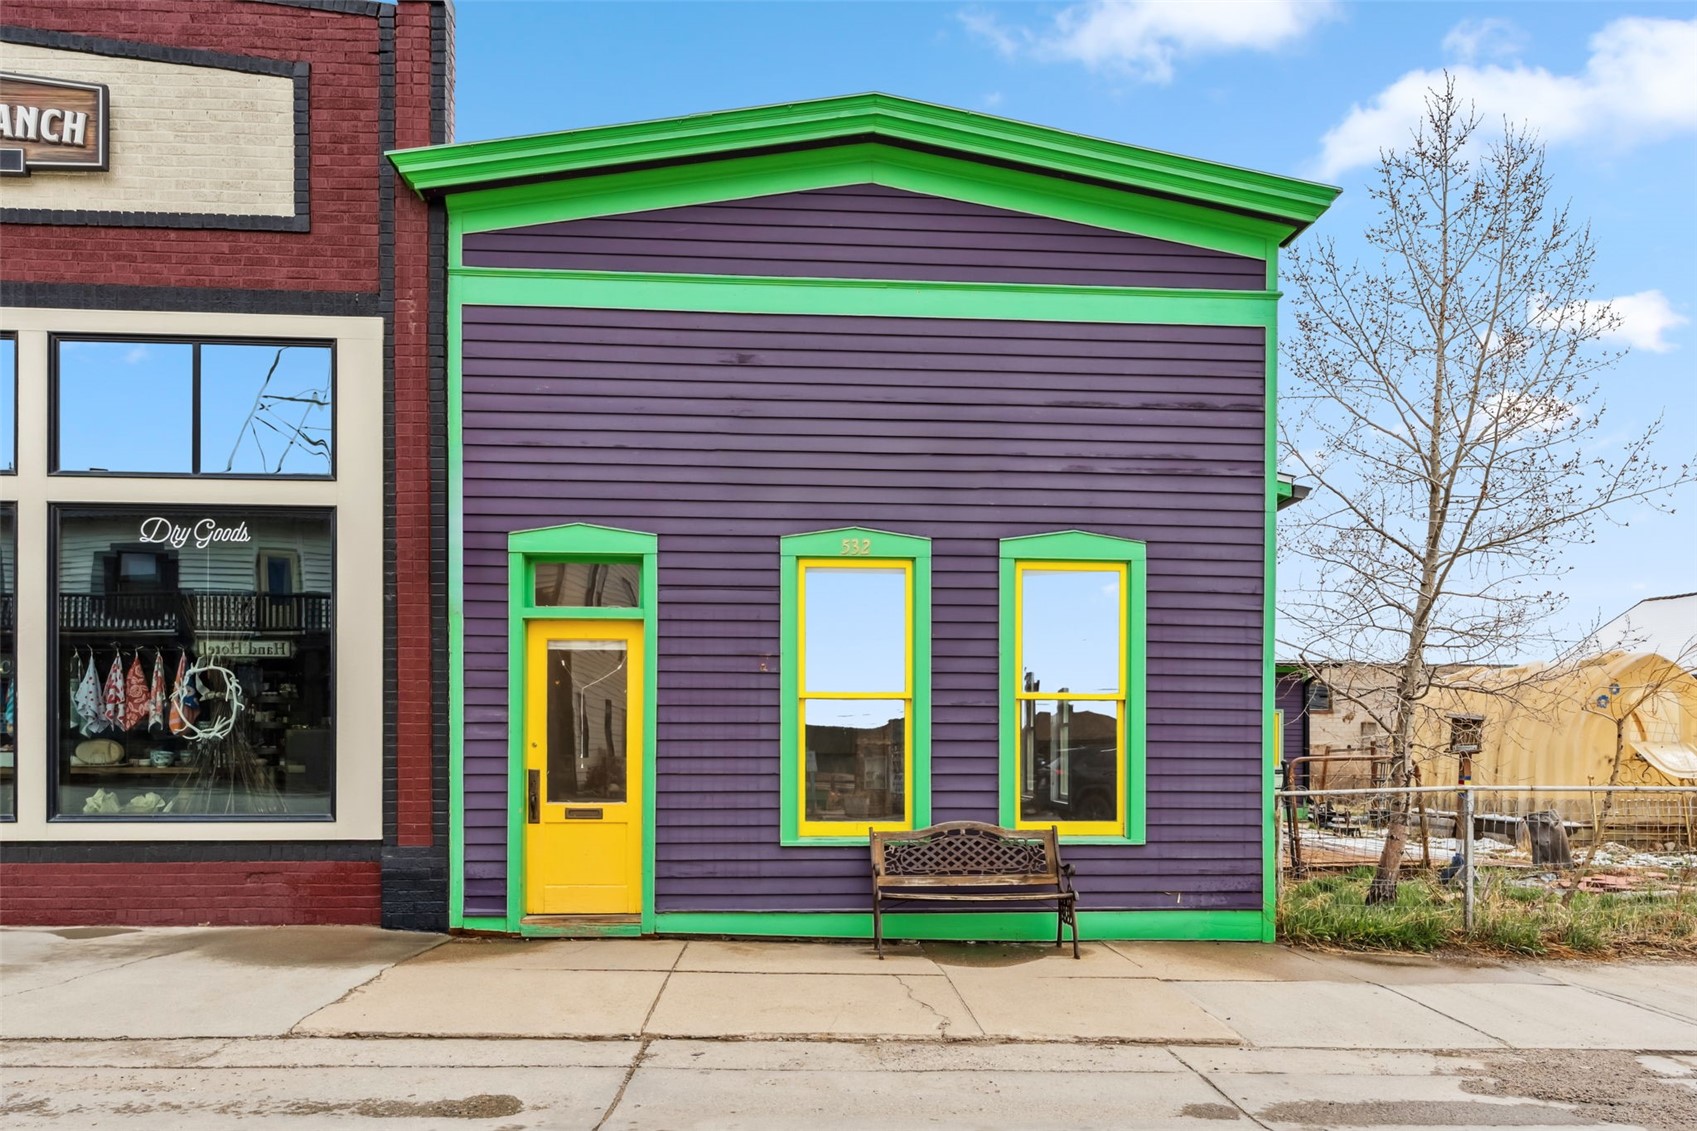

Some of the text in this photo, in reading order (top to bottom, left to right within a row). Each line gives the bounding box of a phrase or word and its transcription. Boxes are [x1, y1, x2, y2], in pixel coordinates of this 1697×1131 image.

[139, 516, 251, 549] Dry Goods
[841, 538, 871, 556] 532
